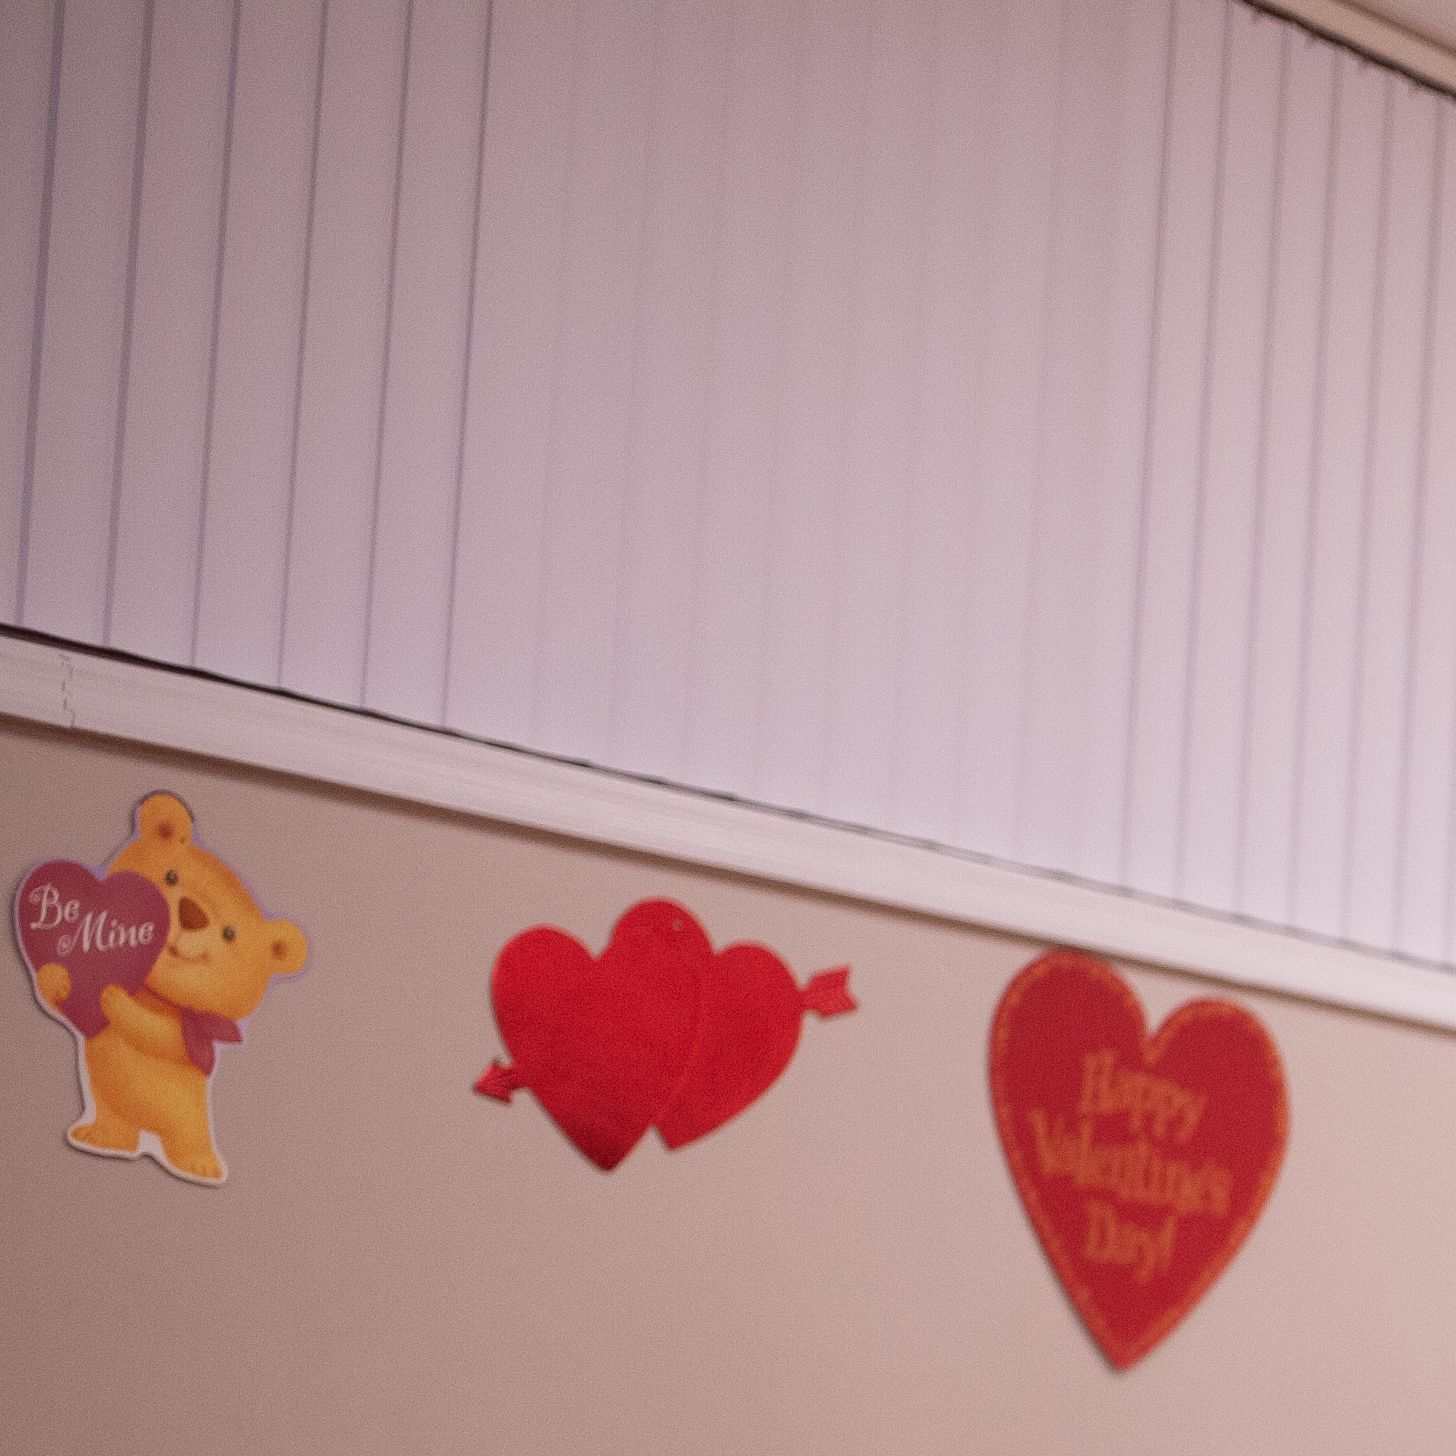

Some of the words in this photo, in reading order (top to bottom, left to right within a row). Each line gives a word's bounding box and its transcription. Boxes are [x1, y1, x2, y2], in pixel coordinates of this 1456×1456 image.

[28, 885, 81, 930] Be
[56, 910, 155, 957] Mine
[1081, 1048, 1208, 1143] Happy
